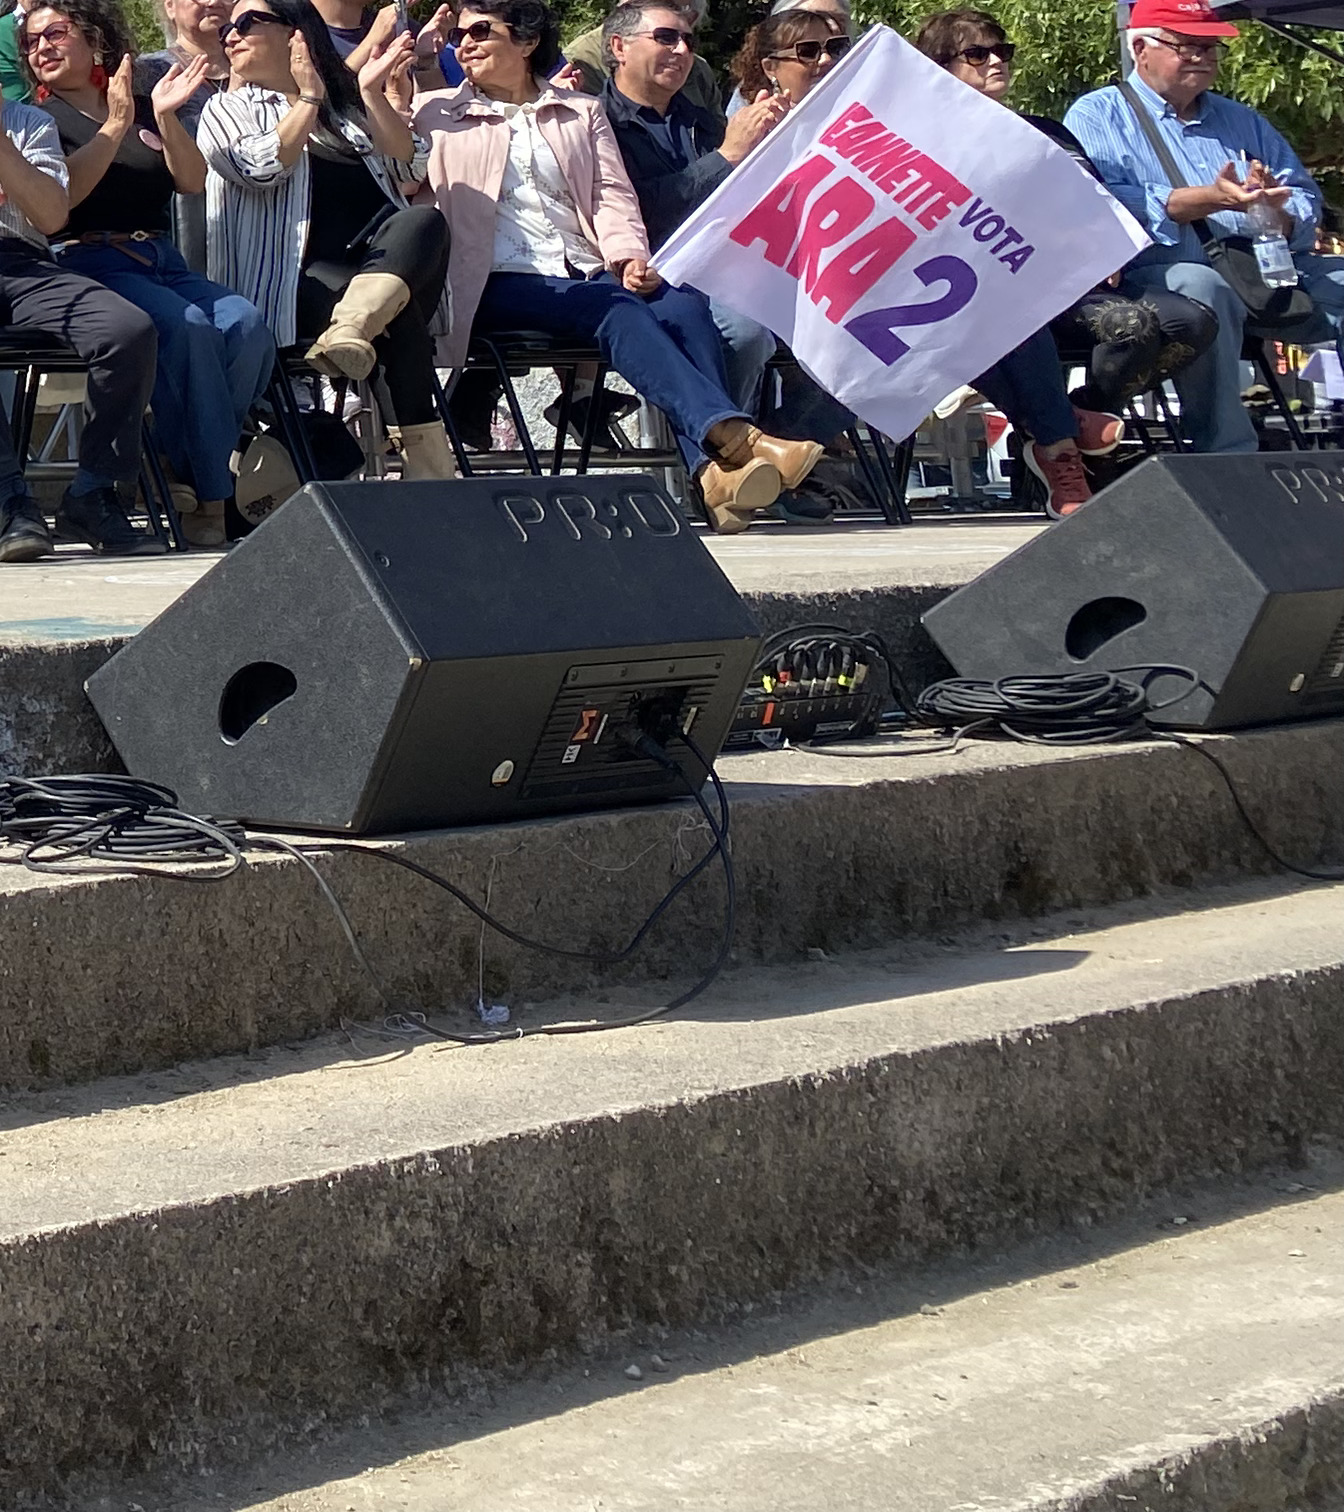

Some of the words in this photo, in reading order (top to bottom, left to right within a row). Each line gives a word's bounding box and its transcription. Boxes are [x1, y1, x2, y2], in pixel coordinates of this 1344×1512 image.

[819, 101, 974, 231] EANNETTE
[729, 153, 918, 325] ARA
[958, 196, 1036, 275] VOTA
[843, 254, 979, 368] 2
